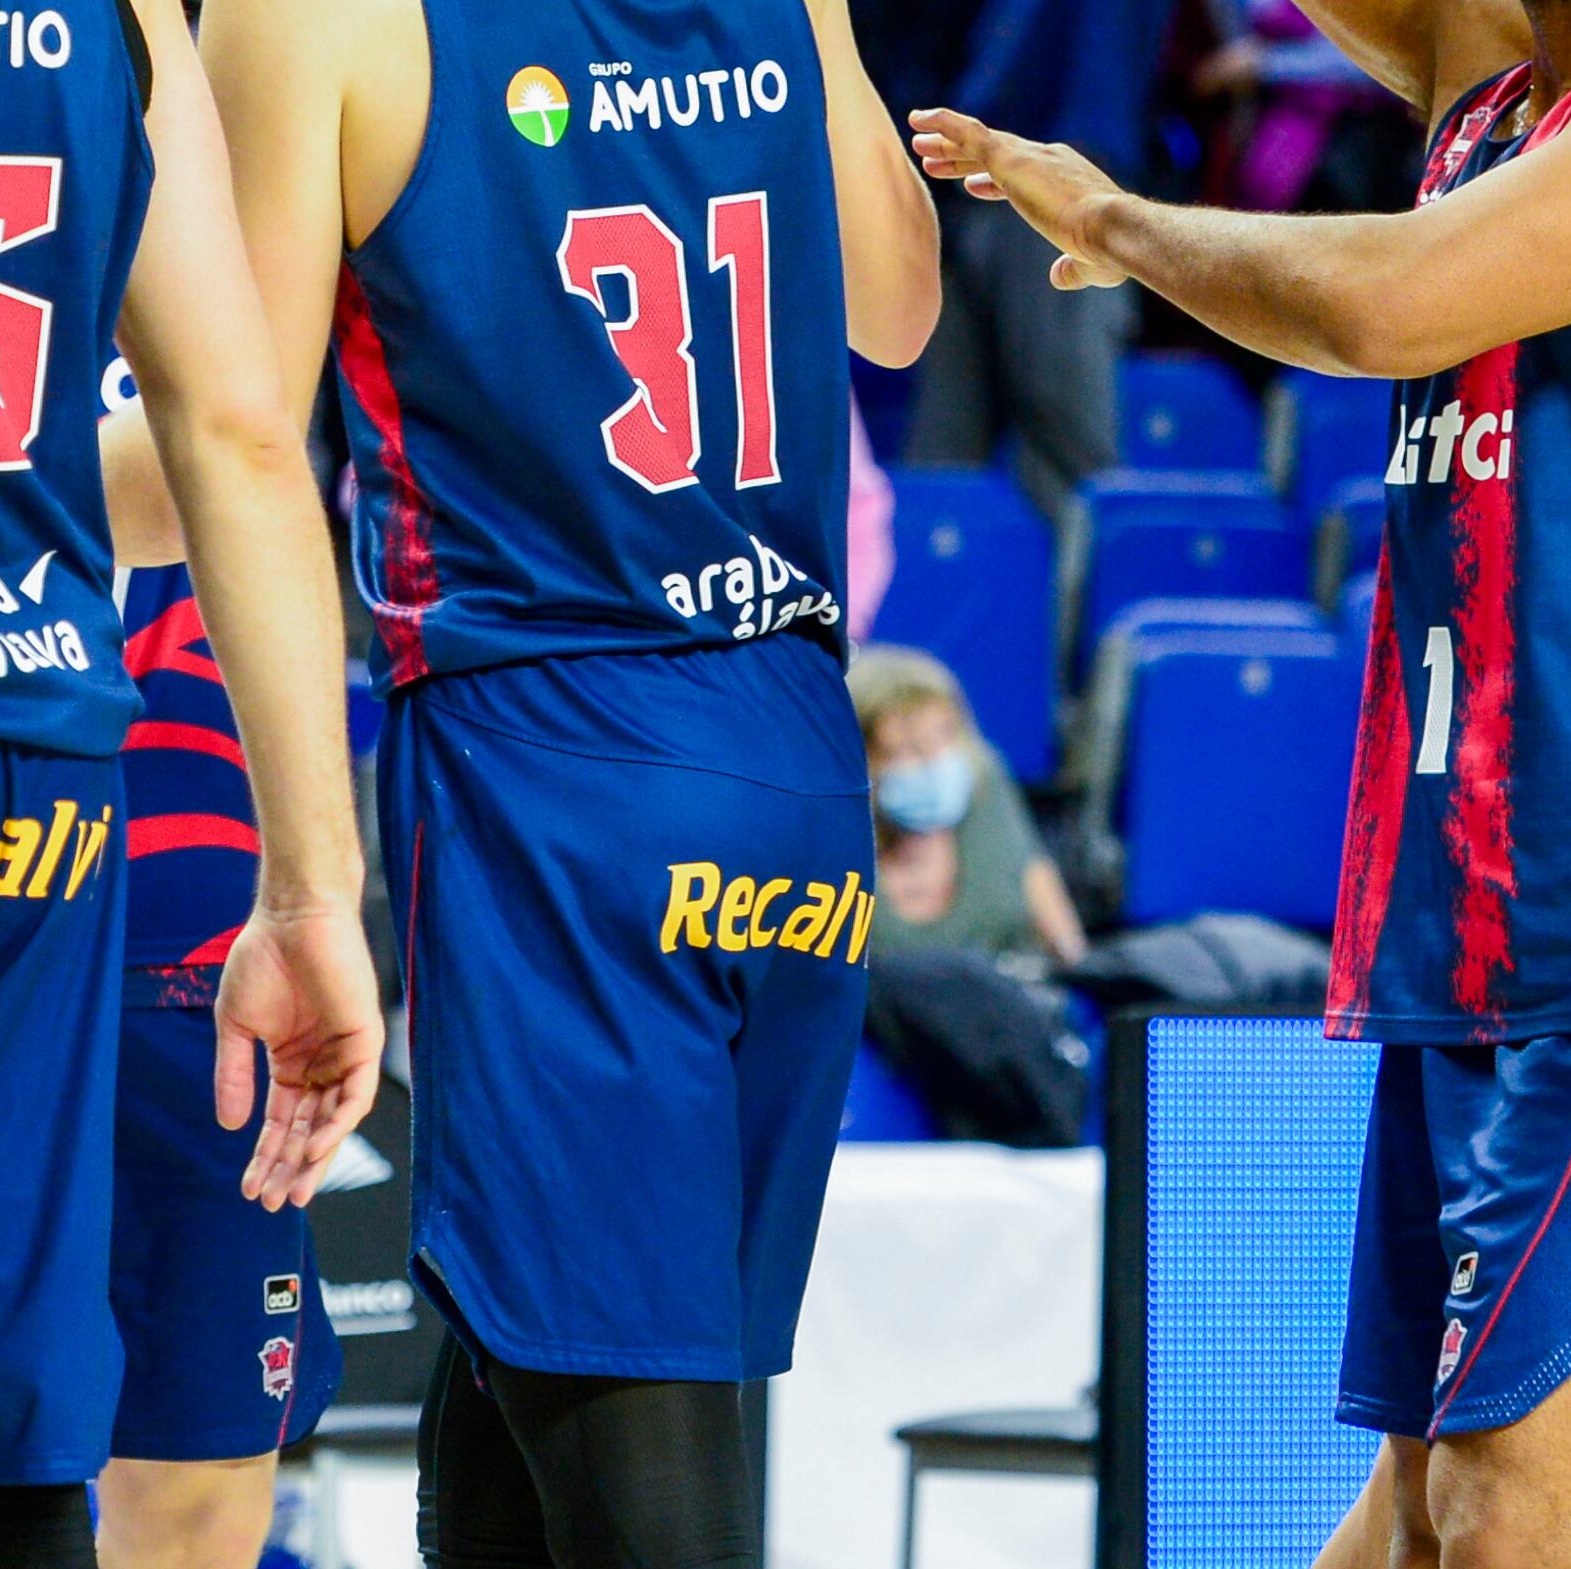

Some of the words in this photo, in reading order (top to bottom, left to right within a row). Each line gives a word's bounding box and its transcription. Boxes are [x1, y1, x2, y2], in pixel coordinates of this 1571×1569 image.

[589, 60, 788, 132] AMUTIO
[557, 191, 782, 494] 31
[661, 535, 807, 618] arab
[1415, 626, 1453, 774] 1
